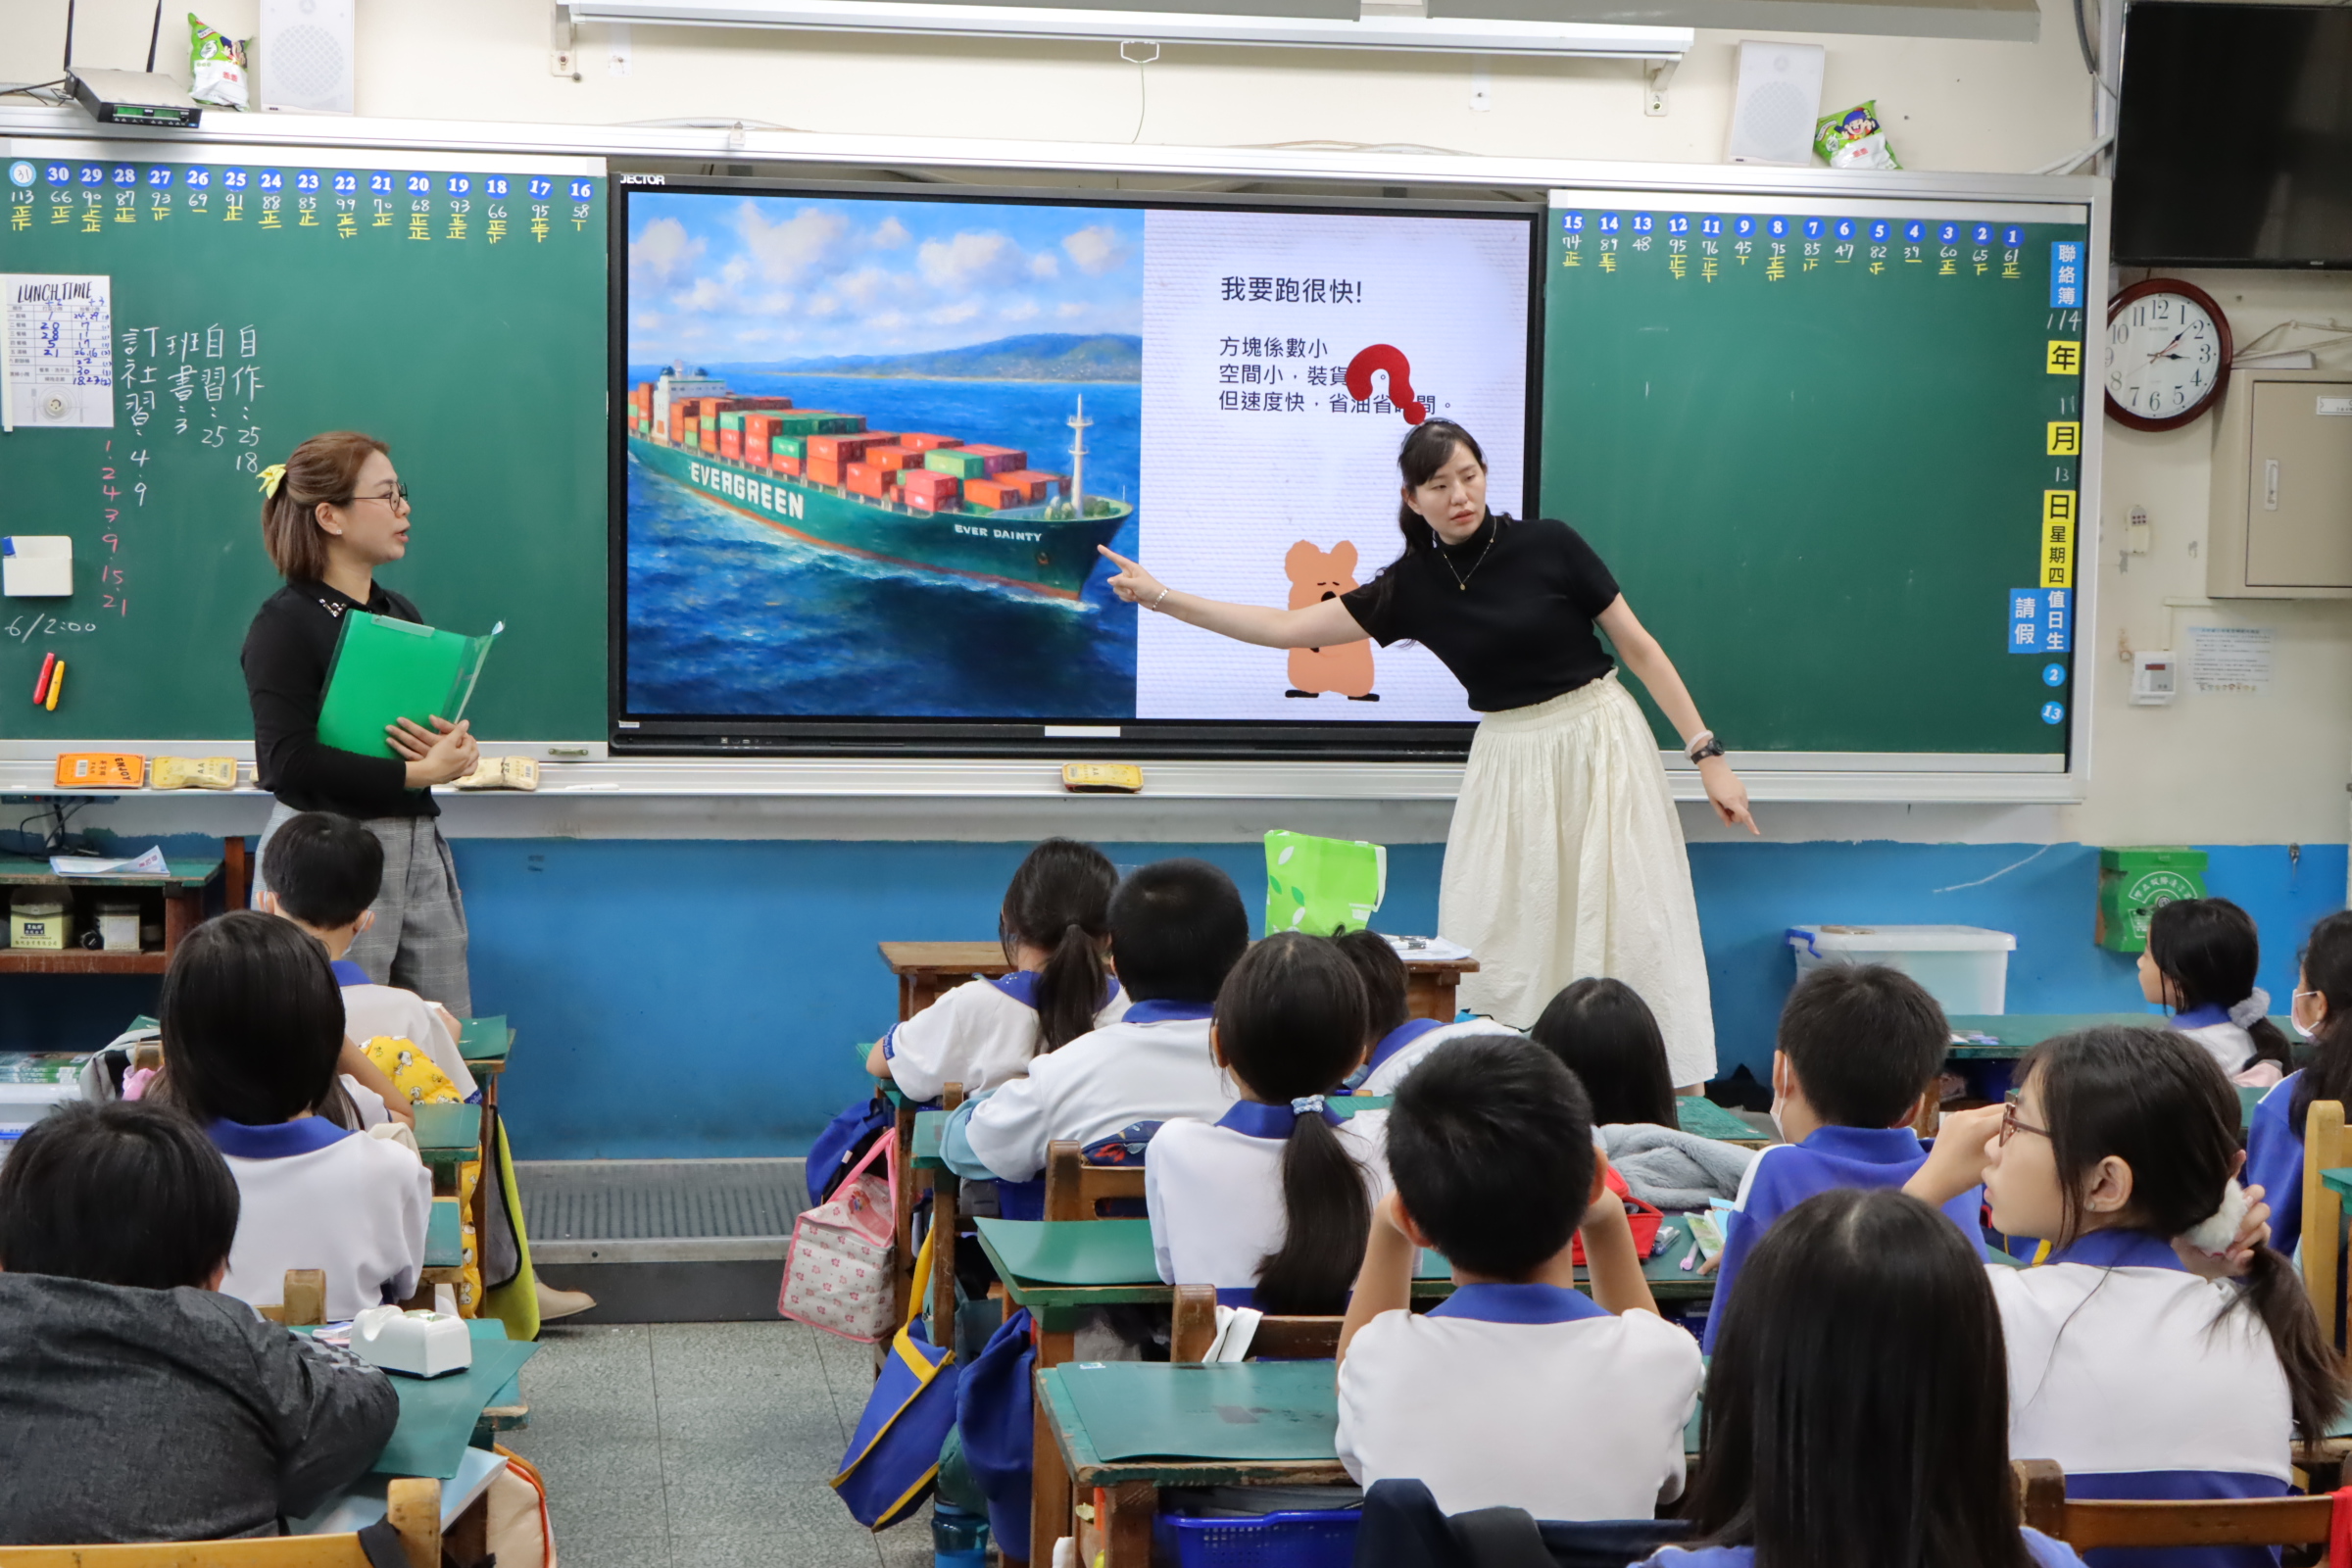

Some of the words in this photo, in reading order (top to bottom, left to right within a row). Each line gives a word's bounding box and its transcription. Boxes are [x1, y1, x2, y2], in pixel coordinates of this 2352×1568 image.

[18, 169, 30, 181] 31
[48, 167, 70, 181] 30
[81, 169, 103, 182] 29
[114, 169, 136, 182] 28
[149, 171, 172, 184] 27
[186, 170, 210, 186] 26
[224, 172, 247, 186] 25
[261, 173, 282, 188] 24
[298, 174, 319, 189] 23
[334, 176, 356, 190] 22
[370, 175, 391, 191] 21
[408, 176, 430, 192] 20
[448, 177, 469, 193] 19
[487, 179, 508, 194] 18
[529, 179, 551, 196] 17
[570, 183, 591, 197] 16
[620, 173, 665, 185] JECTOR
[11, 190, 34, 204] 113
[51, 190, 73, 203] 66
[82, 190, 102, 207] 90
[116, 190, 135, 206] 87
[151, 192, 172, 207] 93
[188, 193, 208, 207] 69
[225, 193, 243, 208] 91
[263, 195, 281, 210] 88
[298, 197, 317, 210] 85
[336, 198, 356, 211] 99
[373, 198, 392, 215] 70
[411, 199, 430, 212] 68
[450, 200, 471, 213] 93
[488, 204, 508, 219] 66
[531, 204, 550, 220] 95
[572, 204, 590, 219] 58
[1564, 216, 1583, 229] 15
[1600, 217, 1618, 230] 14
[1633, 217, 1652, 230] 13
[1669, 218, 1688, 232] 12
[1702, 220, 1720, 233] 11
[1740, 220, 1749, 233] 9
[1773, 220, 1783, 233] 8
[1808, 222, 1818, 234] 7
[1839, 222, 1849, 235] 6
[1875, 224, 1884, 237] 5
[1909, 225, 1920, 237] 4
[1943, 226, 1954, 239] 3
[1978, 227, 1987, 240] 2
[2008, 230, 2017, 243] 1
[1562, 234, 1583, 251] 74
[1600, 239, 1619, 252] 89
[1633, 236, 1652, 252] 48
[1669, 239, 1687, 254] 95
[1702, 240, 1719, 255] 76
[1734, 240, 1752, 255] 45
[1771, 242, 1787, 257] 95
[1804, 243, 1821, 256] 85
[1835, 244, 1854, 260] 47
[1870, 246, 1887, 259] 82
[1904, 246, 1920, 259] 39
[1939, 246, 1958, 258] 60
[1972, 249, 1988, 262] 65
[2004, 249, 2019, 263] 61
[2057, 244, 2076, 306] 聯絡簿
[18, 283, 59, 304] LUNCH
[62, 281, 92, 300] TIME
[1221, 275, 1362, 305] 我要跑很快!
[2132, 306, 2145, 326] 11
[2152, 299, 2169, 320] 12
[2180, 304, 2185, 325] 1
[2046, 310, 2082, 331] 114
[2193, 319, 2204, 339] 2
[2112, 323, 2130, 344] 10
[1219, 336, 1328, 359] 方塊係數小
[2051, 345, 2076, 371] 年
[2199, 344, 2211, 364] 3
[2110, 370, 2123, 391] 8
[2190, 368, 2202, 387] 4
[1218, 391, 1451, 416] 但速度快，省油省間。
[2060, 396, 2075, 415] 11
[2130, 386, 2140, 407] 7
[2149, 391, 2160, 411] 6
[2173, 385, 2184, 405] 5
[201, 425, 228, 448] 25
[237, 425, 262, 447] 25
[2051, 425, 2075, 451] 月
[236, 452, 258, 472] 18
[2055, 466, 2070, 482] 13
[691, 462, 804, 520] EVERGREEN
[954, 523, 989, 537] EVER
[993, 529, 1042, 542] DAINTY
[2048, 525, 2066, 584] 星期四
[2014, 597, 2035, 645] 請假
[2046, 591, 2066, 650] 值日生
[2048, 668, 2059, 681] 2
[2042, 705, 2062, 721] 13
[115, 758, 131, 781] ENJOY
